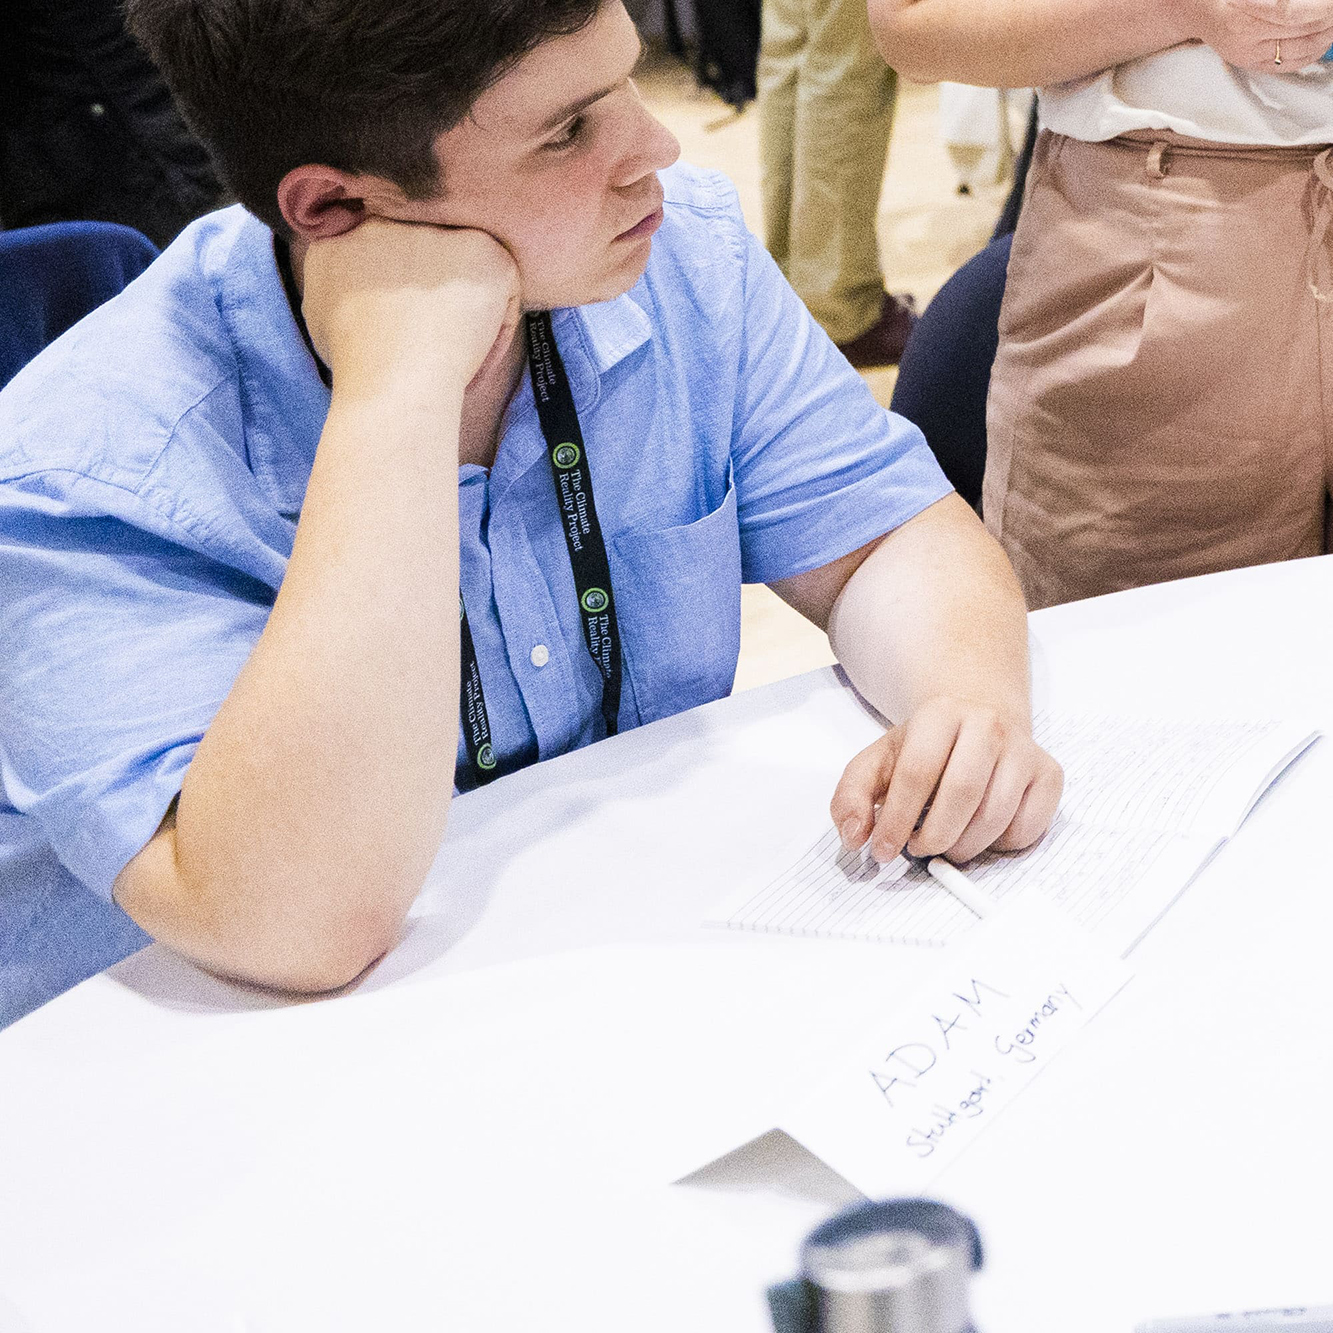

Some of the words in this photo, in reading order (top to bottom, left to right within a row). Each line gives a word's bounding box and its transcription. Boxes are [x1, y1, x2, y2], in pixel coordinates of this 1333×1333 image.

[529, 322, 542, 361] Reality
[537, 319, 547, 340] The
[542, 342, 557, 386] Climate
[535, 363, 550, 402] Project
[571, 469, 582, 491] The
[559, 473, 572, 512] Reality
[567, 513, 583, 552] Project
[575, 492, 591, 534] Climate
[588, 616, 599, 655] Reality
[599, 614, 610, 634] The
[470, 661, 481, 700] Project
[466, 681, 477, 723] Climate
[476, 701, 488, 739] Reality
[994, 981, 1083, 1063] Germany
[867, 977, 1012, 1108] ADAM
